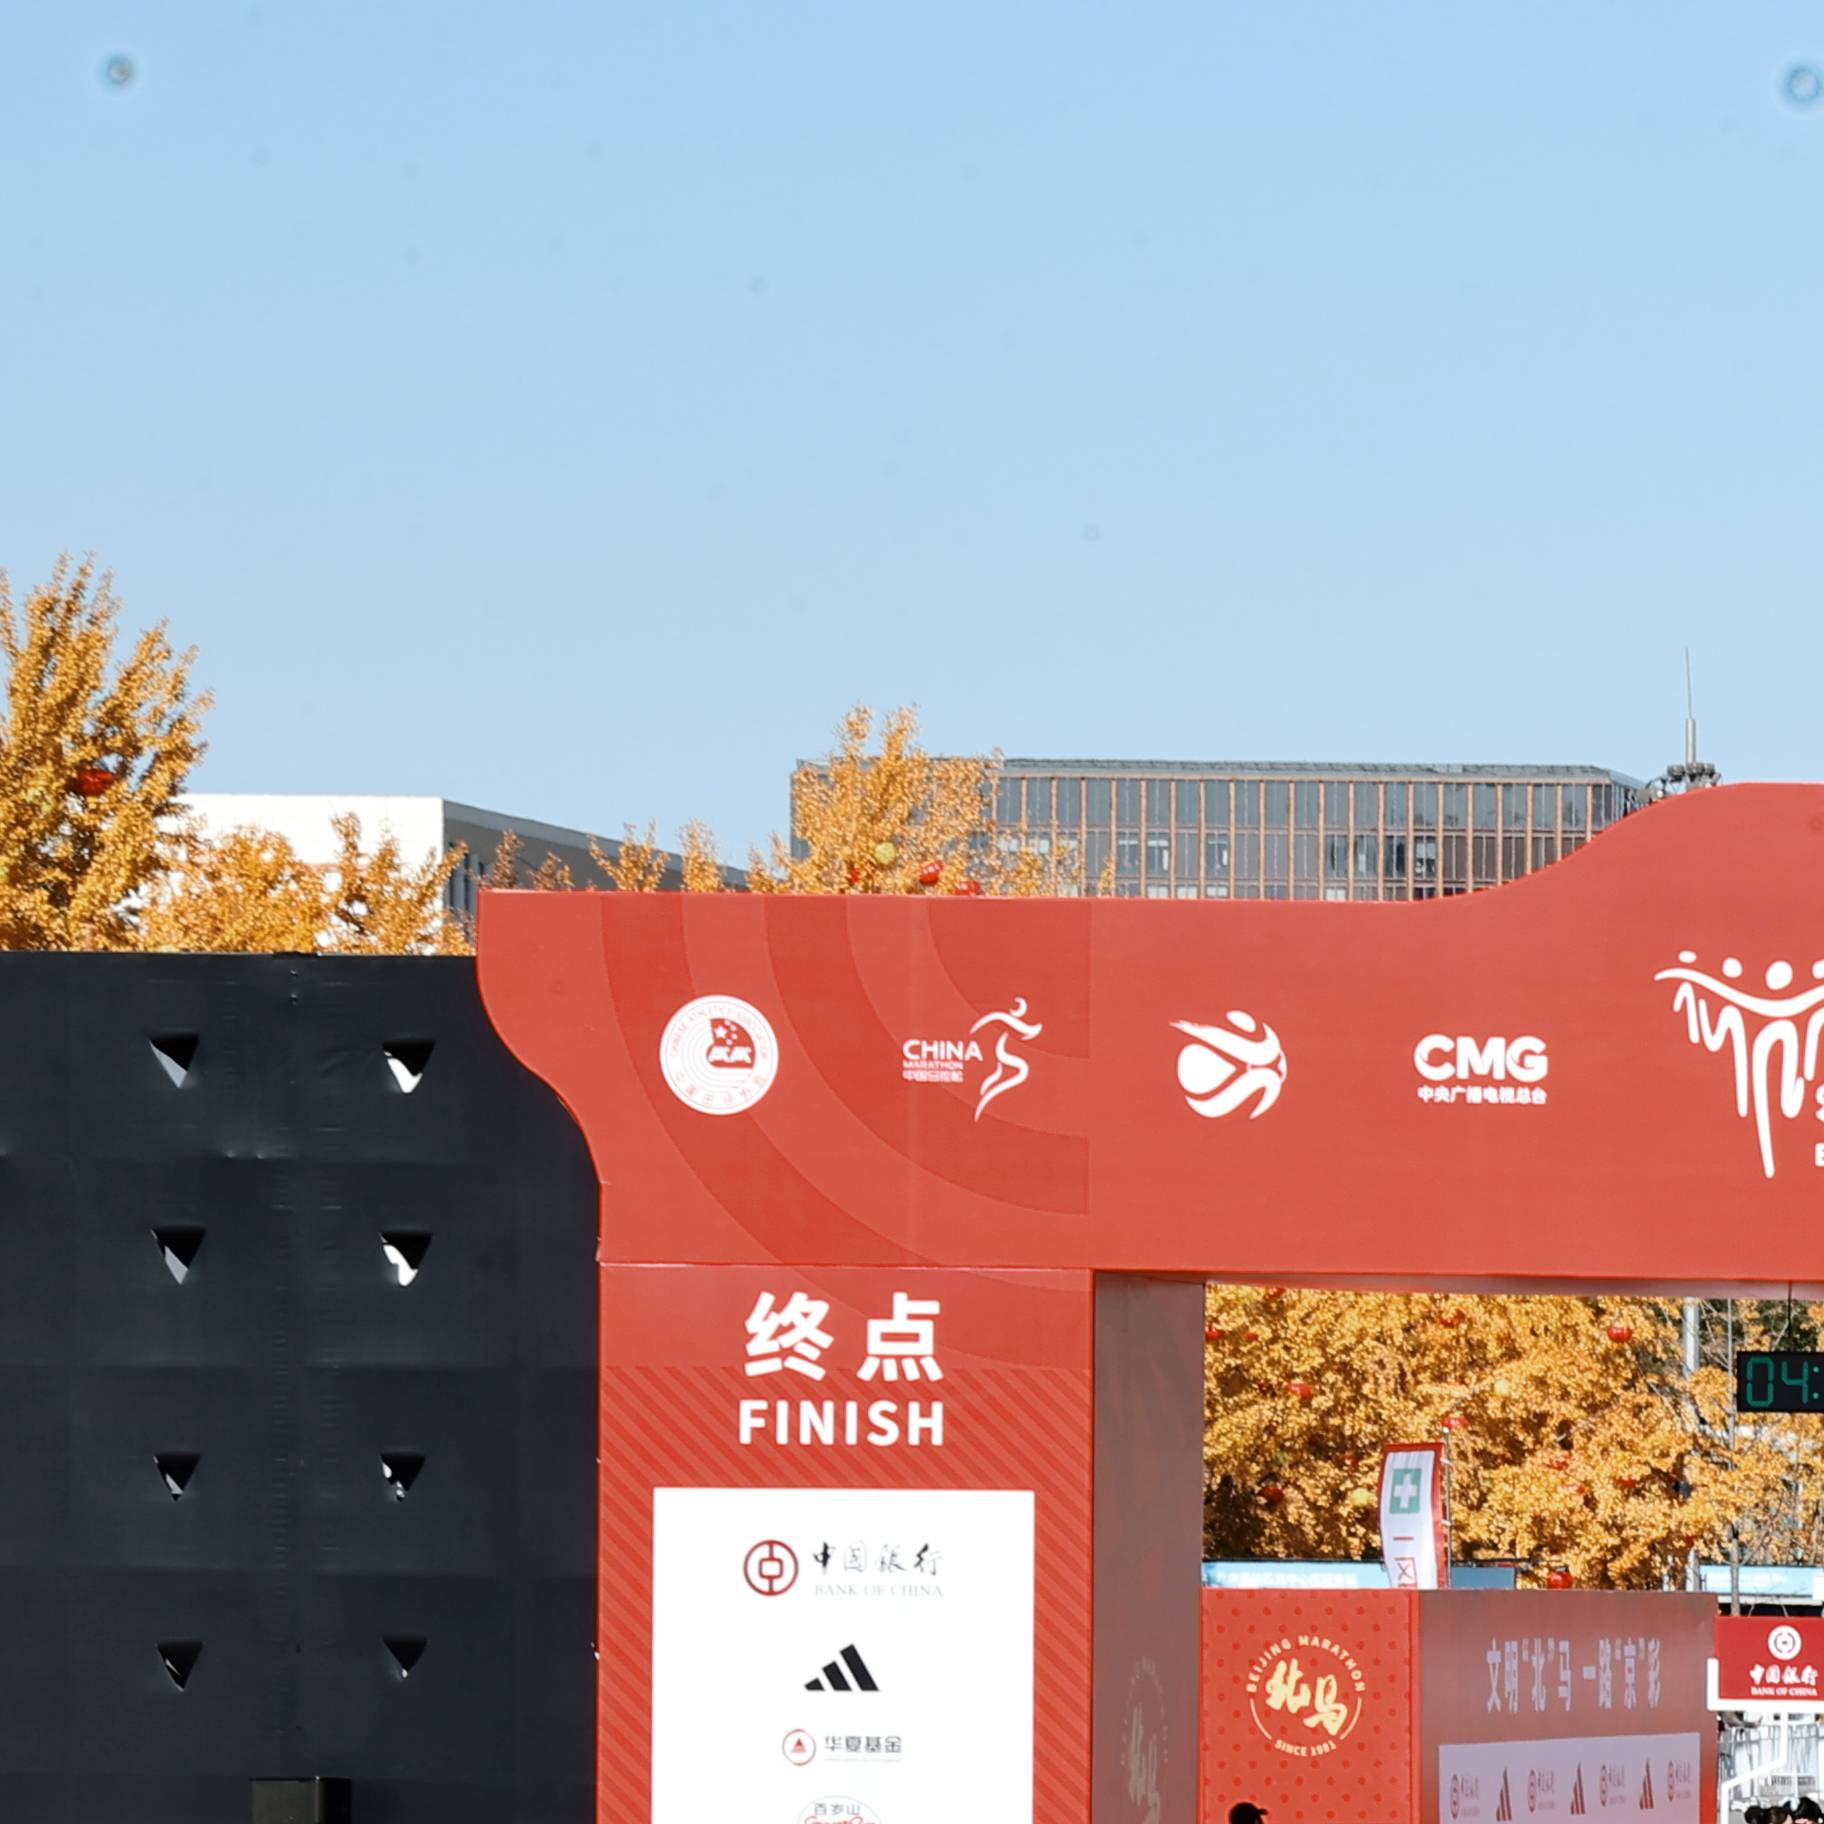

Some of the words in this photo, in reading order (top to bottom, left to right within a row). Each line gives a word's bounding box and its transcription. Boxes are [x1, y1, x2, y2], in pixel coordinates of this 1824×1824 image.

[902, 1039, 983, 1061] CHINA
[1414, 1034, 1548, 1082] CMG
[1417, 1086, 1548, 1105] 中央广播电视总台
[744, 1290, 944, 1382] 终点
[740, 1401, 945, 1447] FINISH
[814, 1583, 859, 1597] BANK
[864, 1583, 887, 1597] OF
[890, 1584, 943, 1598] CHINA
[1245, 1638, 1292, 1693] BEIJING
[1298, 1634, 1366, 1692] MARATHON
[1265, 1658, 1348, 1736] 北马
[1750, 1687, 1774, 1696] BANK
[1788, 1688, 1818, 1697] CHINA
[823, 1735, 902, 1754] 华夏基金
[1274, 1739, 1308, 1757] SINCE
[813, 1802, 861, 1816] 百岁山
